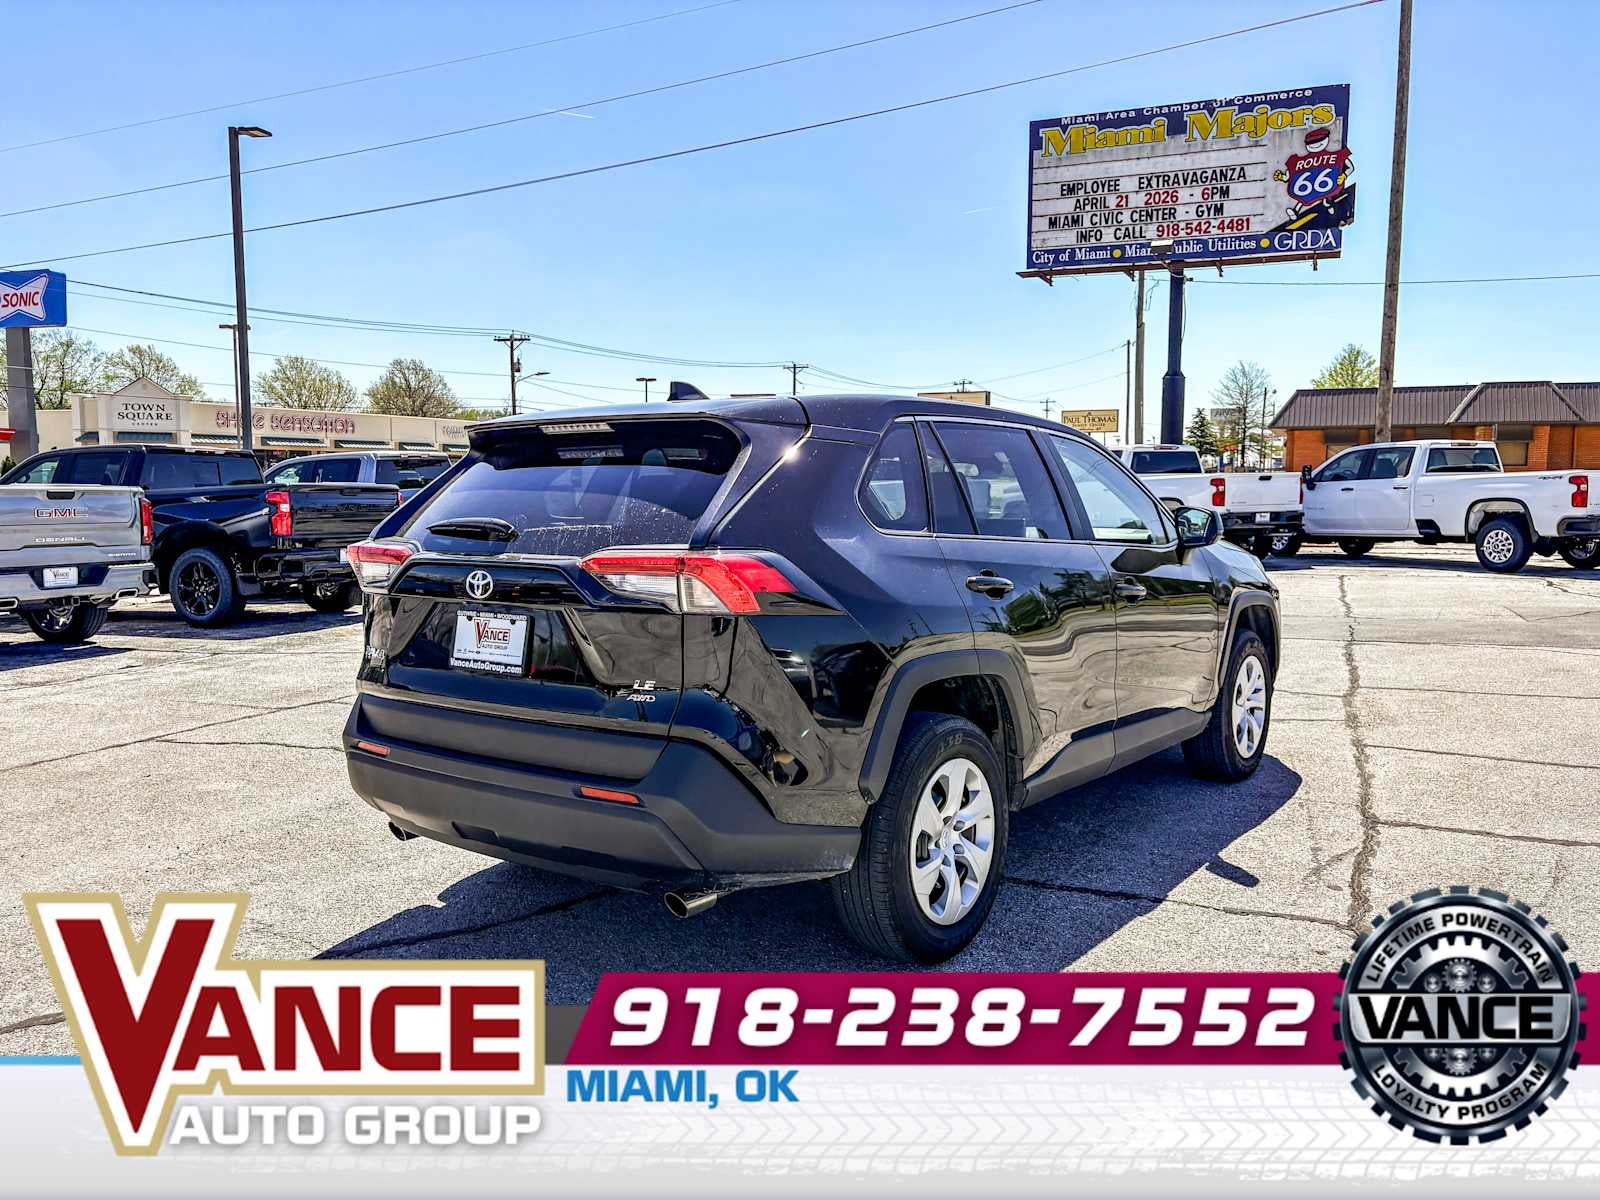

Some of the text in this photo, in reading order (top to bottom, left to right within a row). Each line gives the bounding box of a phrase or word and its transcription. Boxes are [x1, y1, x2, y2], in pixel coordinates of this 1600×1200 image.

[1061, 114, 1099, 125] Miami
[1106, 109, 1136, 120] Area
[1143, 101, 1206, 116] Chamber
[1234, 89, 1313, 104] Commerce
[1041, 104, 1335, 157] Miami Majors
[1296, 154, 1337, 170] ROUTE
[1060, 166, 1247, 196] EMPLOYEE EXTRAVAGANZA
[1293, 168, 1333, 196] 66
[1073, 196, 1110, 212] APRIL
[1115, 194, 1129, 208] 21
[1144, 190, 1180, 206] 2026
[1201, 185, 1230, 201] 6PM
[1048, 214, 1084, 229] MIAMI
[1090, 211, 1124, 226] CIVIC
[1130, 207, 1177, 223] CENTER
[1195, 202, 1224, 218] GYM
[1076, 217, 1250, 243] INFO CALL 918-542-4481
[1032, 228, 1337, 266] City of Miami Mia ublic Utilities GRDA
[1, 291, 40, 308] SONIC
[117, 411, 173, 421] SQUARE
[122, 402, 166, 412] TOWN
[1082, 415, 1116, 424] THOMAS
[34, 507, 89, 518] GMC
[475, 620, 510, 647] VANCE
[450, 657, 522, 674] VanceAutoGroup.com
[633, 680, 656, 690] LE
[626, 694, 656, 702] AWD
